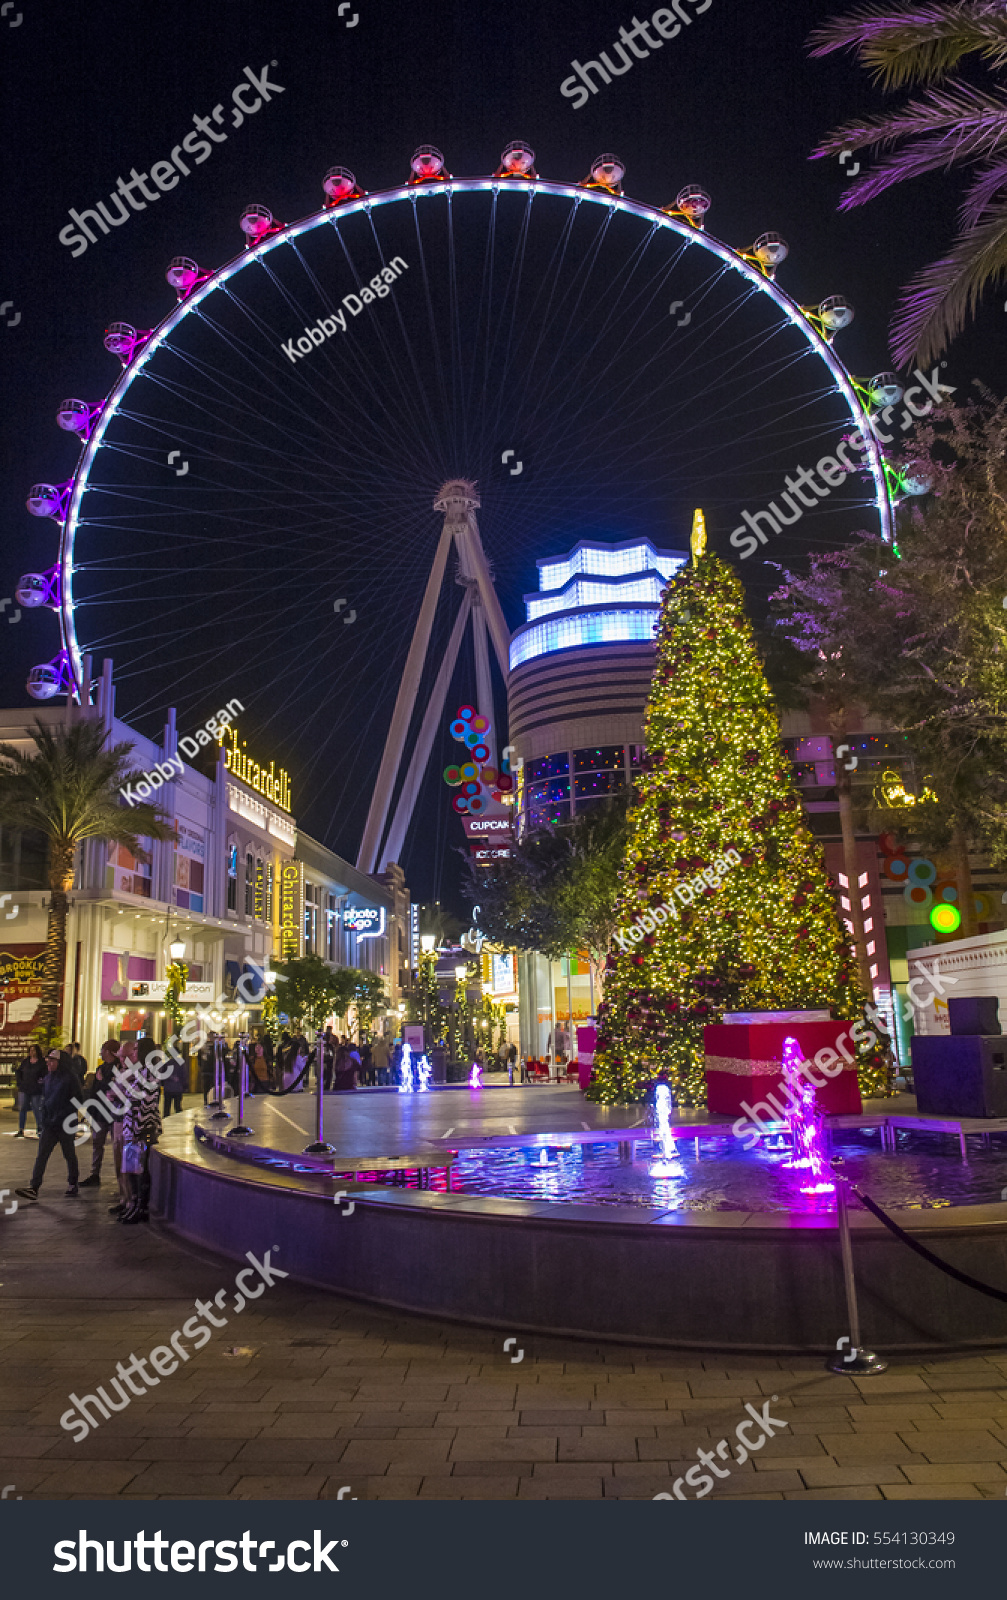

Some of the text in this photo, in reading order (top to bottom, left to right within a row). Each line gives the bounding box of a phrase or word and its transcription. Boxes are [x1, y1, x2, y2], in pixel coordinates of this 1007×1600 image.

[470, 820, 515, 830] CUPCAK
[283, 866, 299, 955] Ghirardelli
[344, 908, 377, 921] photo
[0, 961, 47, 976] BROOKLY
[17, 986, 42, 994] VEGA
[151, 983, 167, 992] Urb
